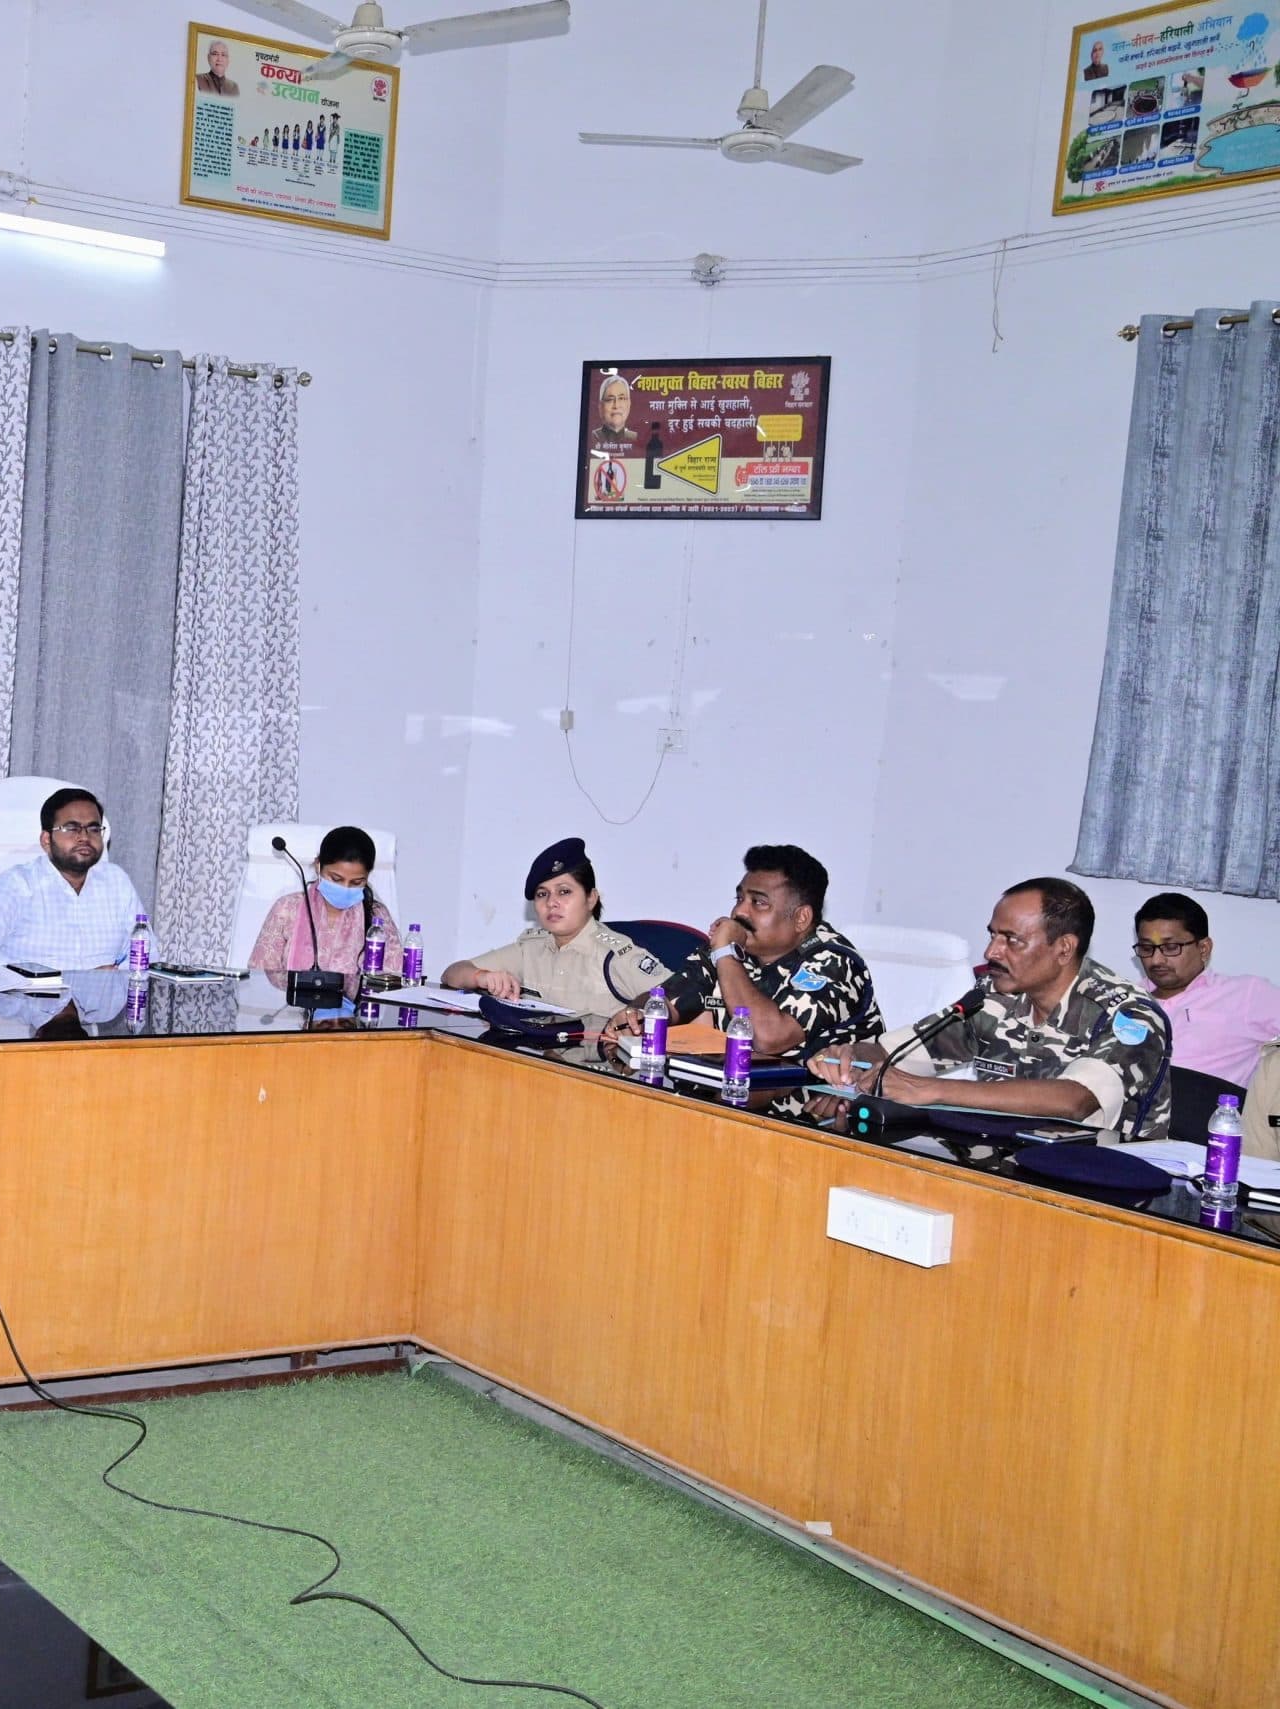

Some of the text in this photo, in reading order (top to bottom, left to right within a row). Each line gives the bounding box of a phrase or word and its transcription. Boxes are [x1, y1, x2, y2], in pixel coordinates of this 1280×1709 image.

[260, 62, 302, 85] कन्या
[272, 81, 321, 104] उत्थान
[637, 374, 685, 396] नशामुक्त
[753, 369, 785, 390] बिहार
[649, 400, 665, 411] नशा
[667, 396, 688, 414] मुक्ति
[690, 397, 698, 410] से
[700, 395, 715, 412] आई
[668, 418, 681, 433] दूर
[682, 414, 695, 433] हुई
